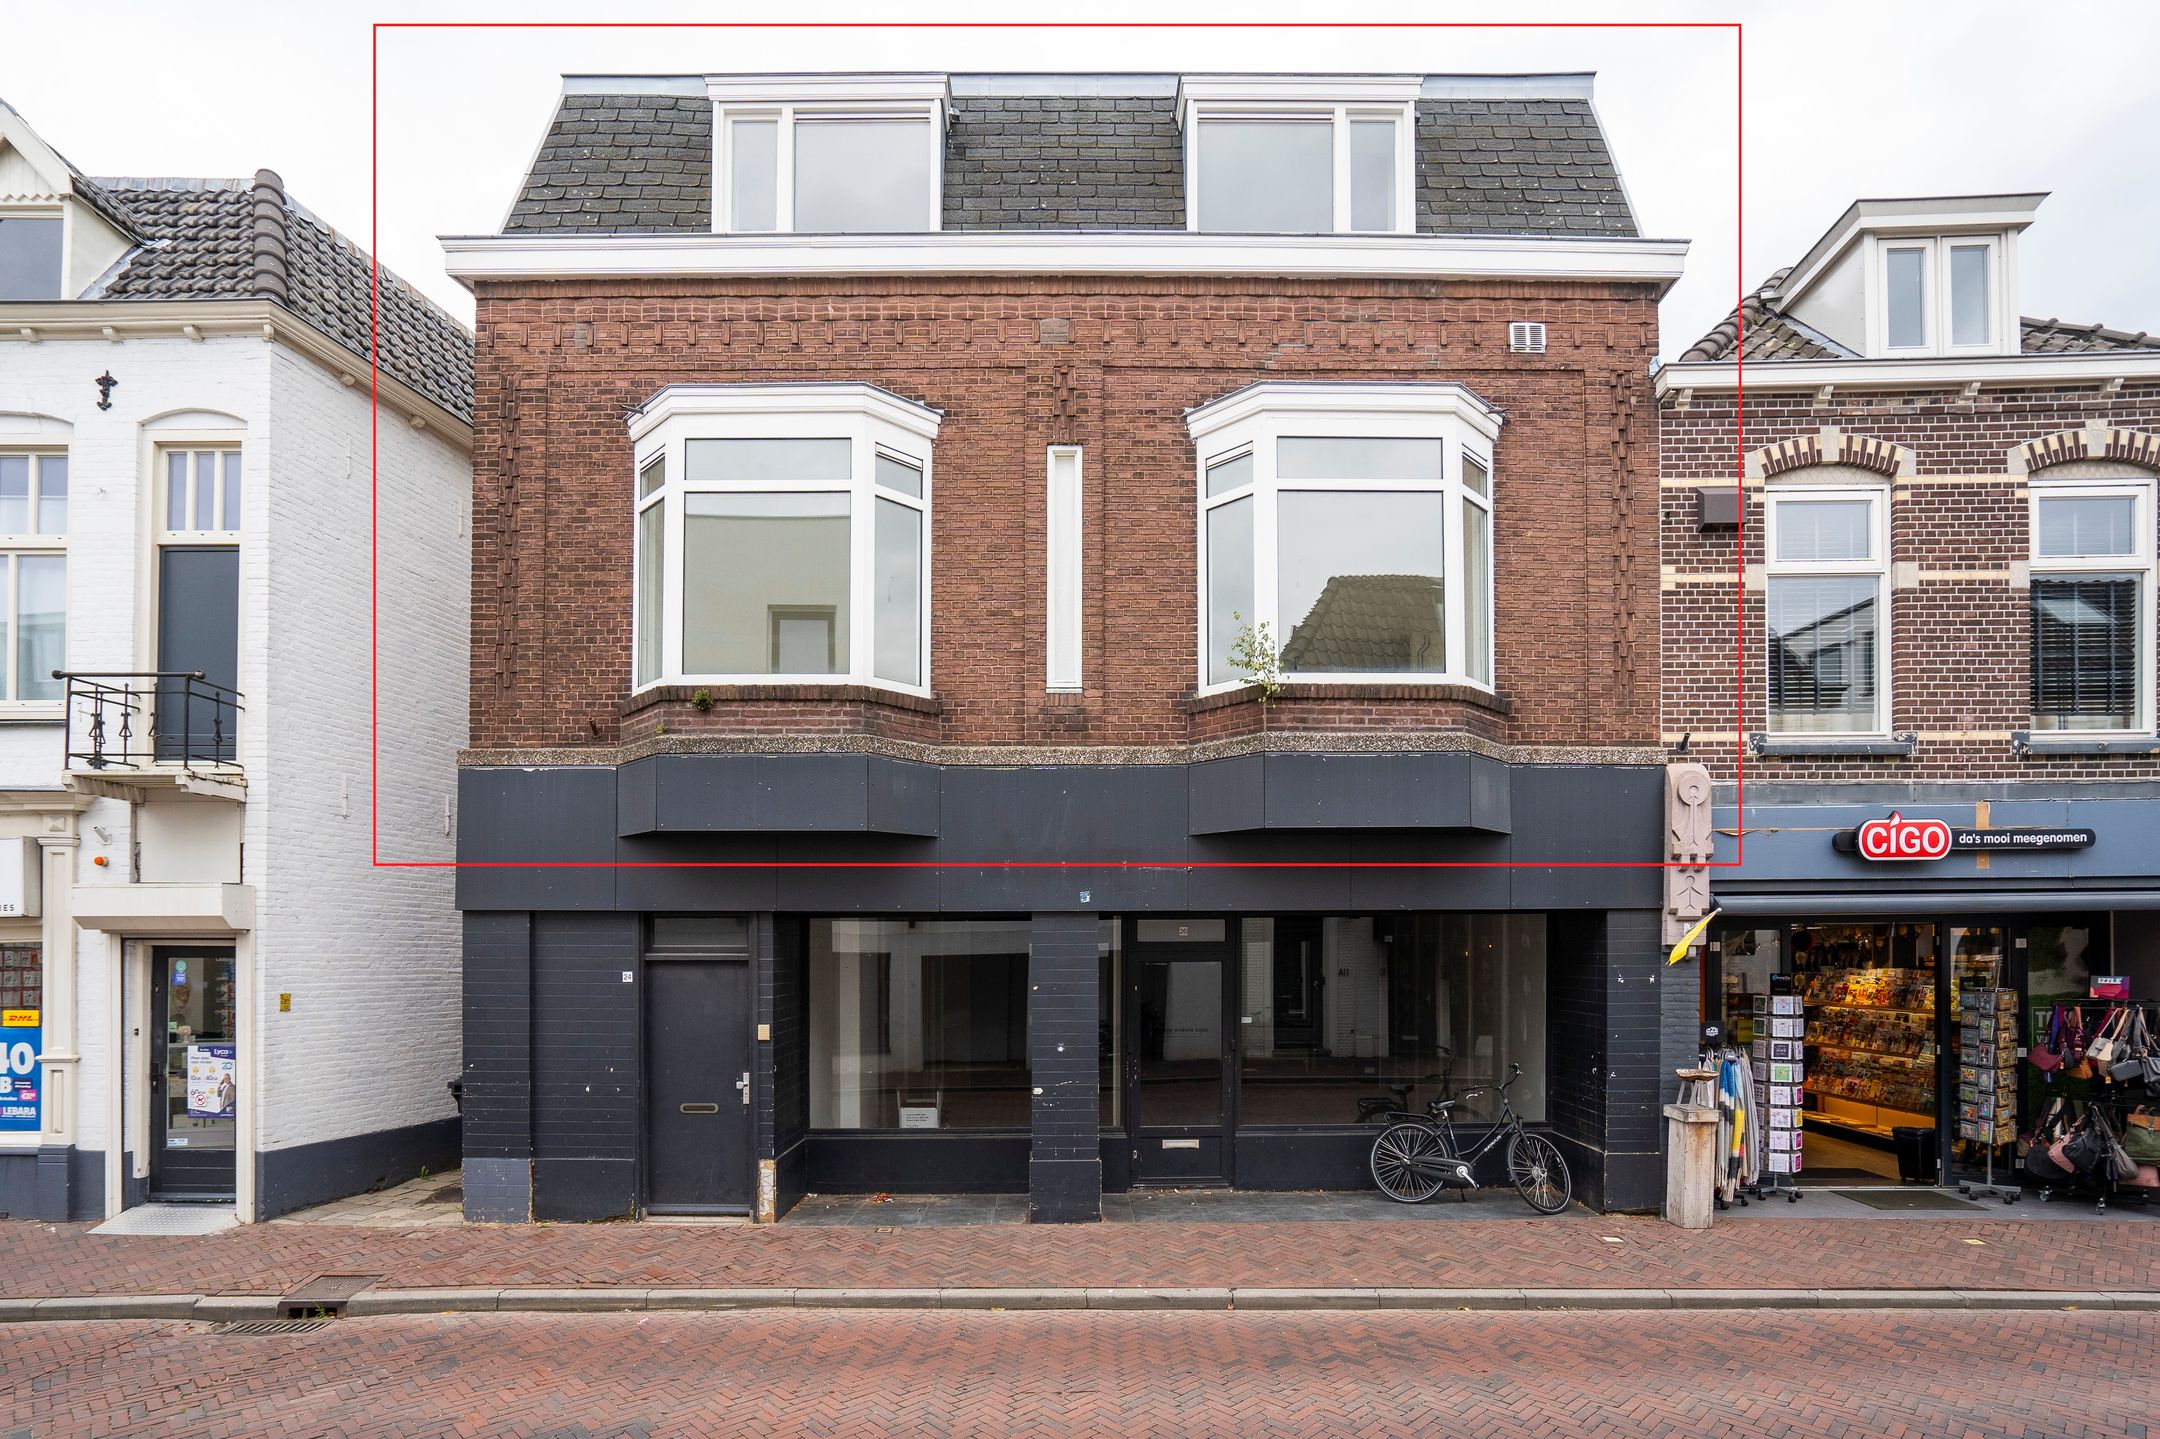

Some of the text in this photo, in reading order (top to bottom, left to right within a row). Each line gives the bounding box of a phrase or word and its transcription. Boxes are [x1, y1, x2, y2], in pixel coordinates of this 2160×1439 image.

[1866, 815, 1946, 854] CIGO
[1959, 833, 2088, 846] da's mooi meegenomen
[623, 973, 632, 981] 24
[213, 1048, 229, 1056] Lyca
[2, 1106, 36, 1115] LEBARA
